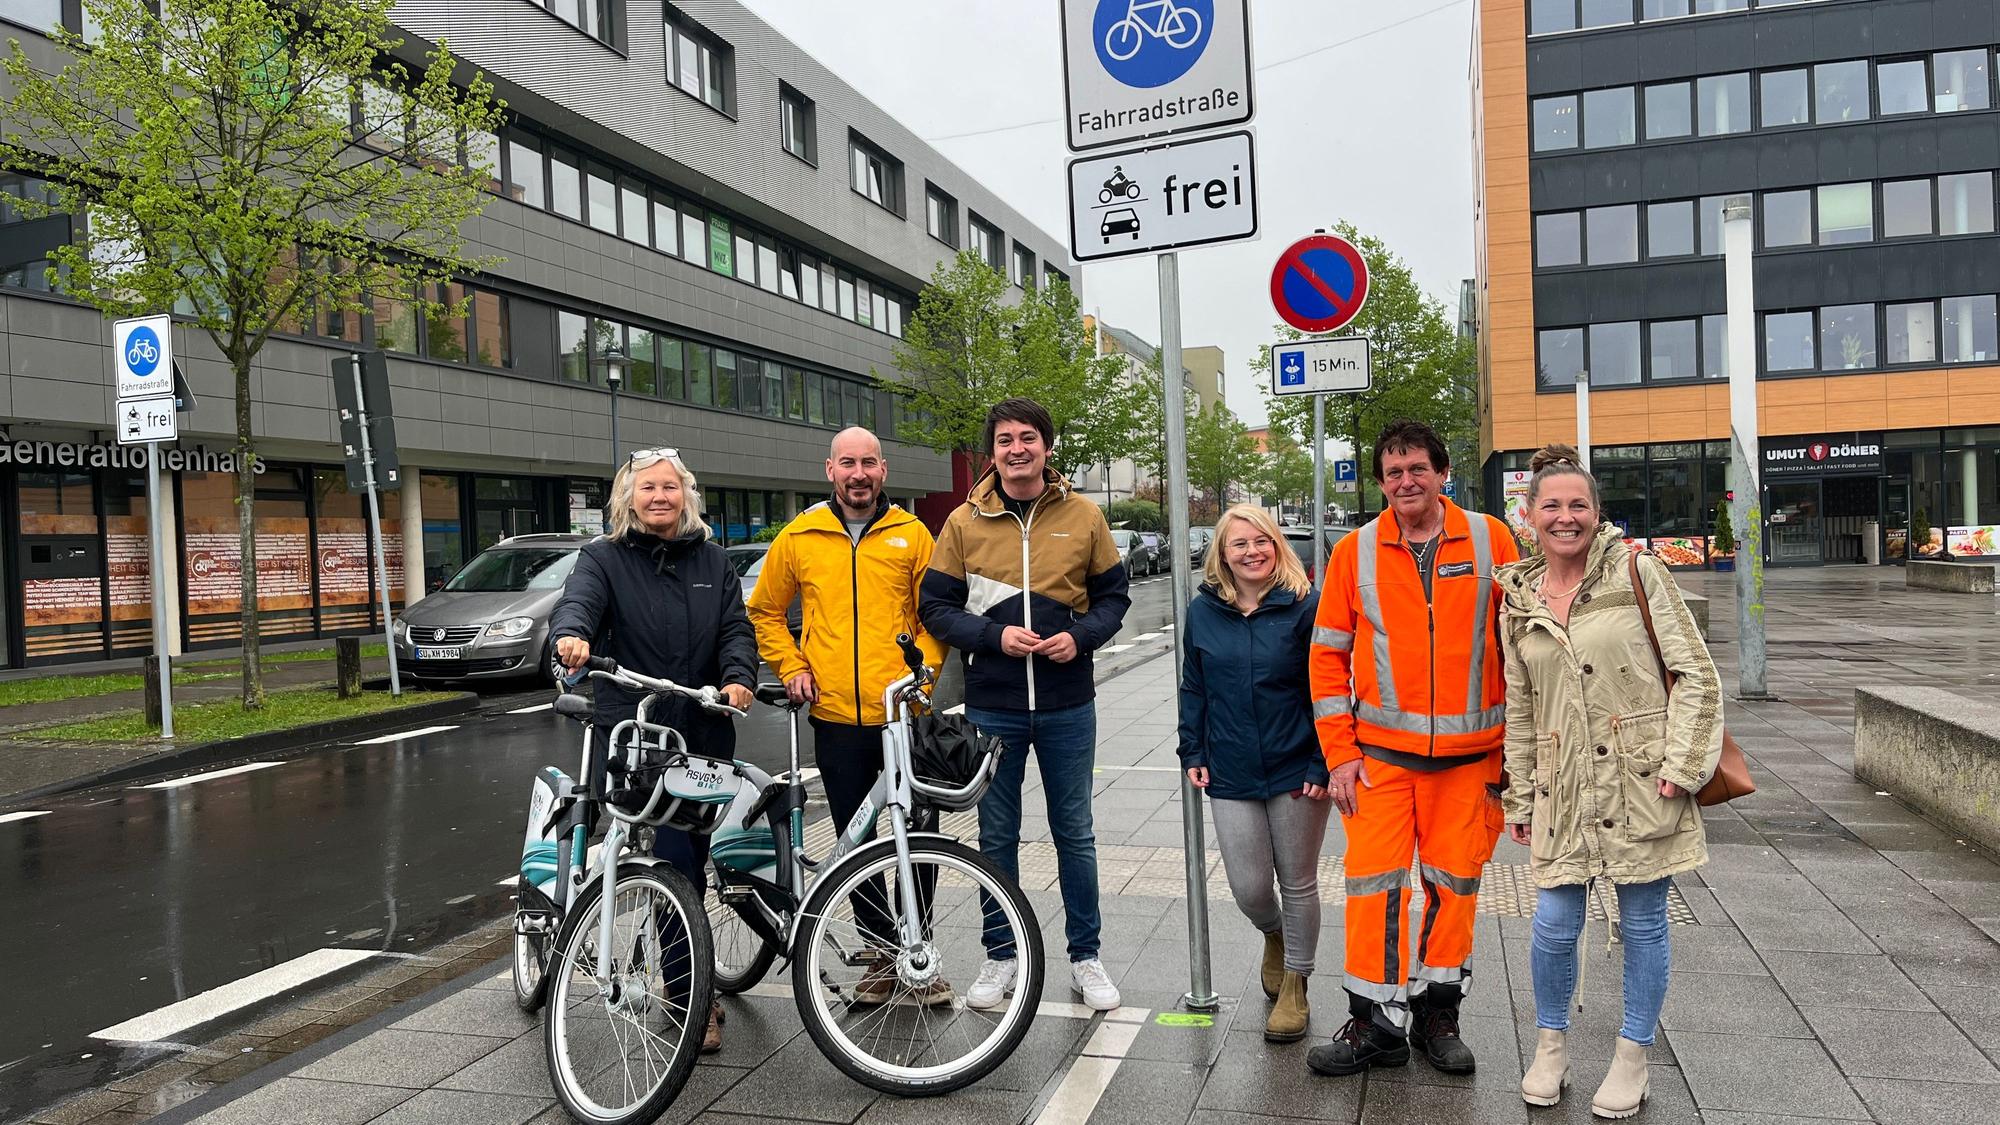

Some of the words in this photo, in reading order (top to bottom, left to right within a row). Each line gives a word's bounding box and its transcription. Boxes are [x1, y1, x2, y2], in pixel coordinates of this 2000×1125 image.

[1078, 88, 1239, 133] Fahrradstraße
[1163, 164, 1242, 216] frei
[121, 378, 169, 392] Fahrradstraße
[147, 409, 171, 428] frei
[0, 430, 266, 475] eneratioenhas
[1766, 448, 1806, 461] UMUT
[1830, 443, 1880, 458] DÖNER
[1339, 462, 1351, 479] P
[419, 650, 428, 658] SU
